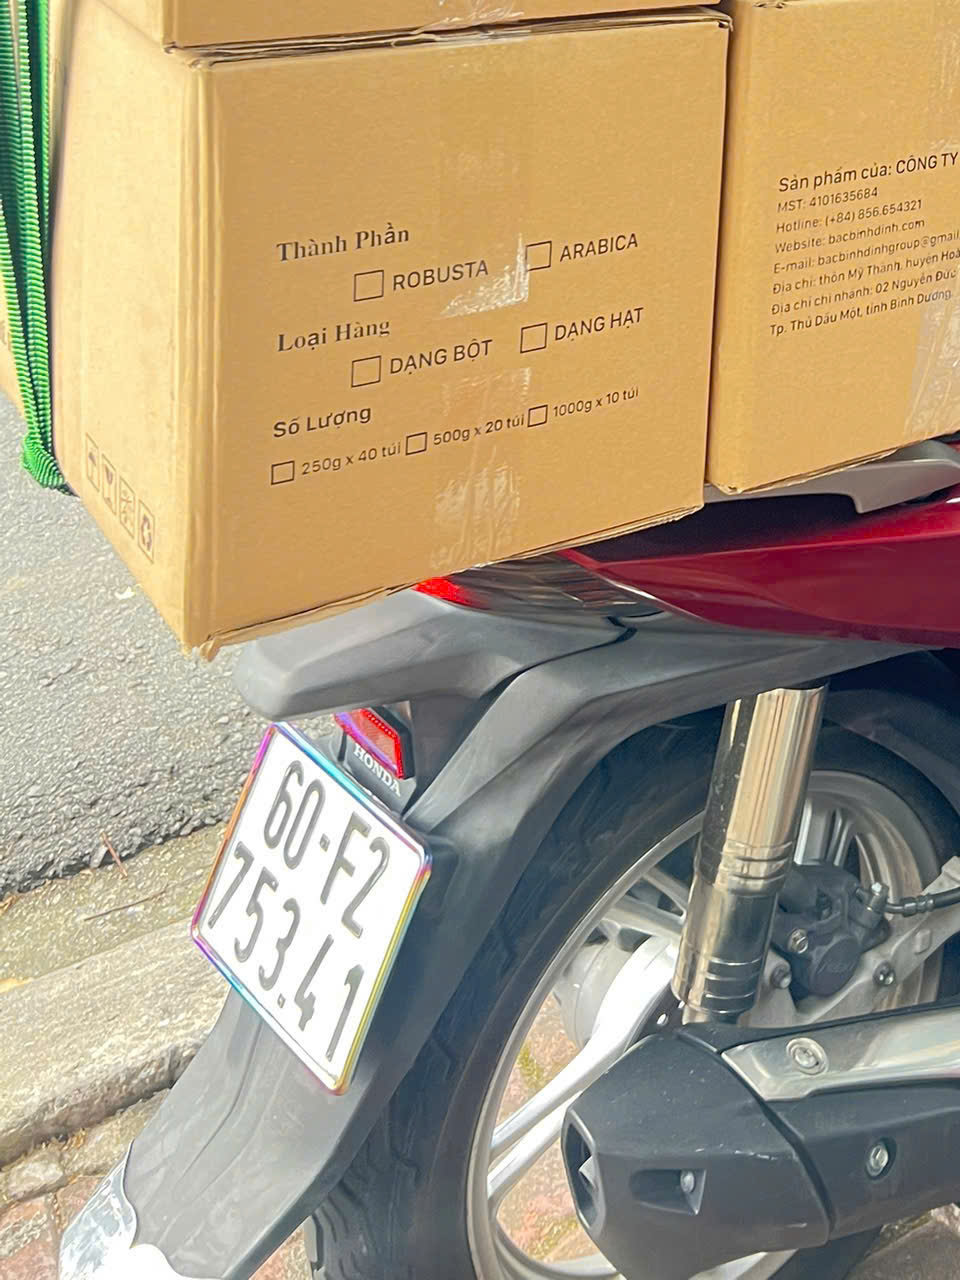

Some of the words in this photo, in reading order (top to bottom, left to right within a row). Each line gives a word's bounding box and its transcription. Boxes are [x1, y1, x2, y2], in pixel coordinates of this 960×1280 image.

[779, 174, 809, 193] Sản
[861, 162, 892, 179] của:
[896, 155, 938, 174] CÔNG
[941, 152, 959, 167] TY
[776, 218, 822, 234] Hotline:
[825, 211, 856, 227] (+84)
[858, 199, 922, 220] 856.654321
[777, 198, 806, 213] MST:
[809, 186, 878, 207] 4101635684
[276, 234, 348, 263] Thành
[355, 222, 410, 251] Phần
[775, 237, 826, 254] Website:
[828, 219, 925, 245] bacbinhdinh.com
[392, 260, 490, 292] ROBUSTA
[559, 233, 639, 263] ARABICA
[773, 256, 815, 274] E-mail:
[875, 281, 890, 295] 02
[278, 327, 328, 353] Loại
[335, 320, 391, 343] Hàng
[390, 349, 448, 376] DẠNG
[453, 337, 493, 363] BỘT
[554, 316, 606, 342] DẠNG
[610, 307, 644, 331] HẠT
[770, 323, 788, 337] Tp.
[273, 417, 301, 438] Số
[306, 407, 372, 433] Lượng
[301, 457, 342, 477] 250g
[346, 455, 354, 466] x
[357, 448, 378, 464] 40
[382, 441, 401, 458] túi
[433, 427, 471, 448] 500g
[474, 426, 482, 437] x
[485, 419, 503, 434] 20
[506, 413, 525, 430] túi
[552, 399, 593, 419] 1000g
[595, 397, 603, 408] x
[606, 390, 620, 406] 10
[622, 385, 639, 401] túi
[352, 742, 402, 797] HONDA
[263, 760, 390, 939] 60-F2
[207, 840, 364, 1062] 753.41
